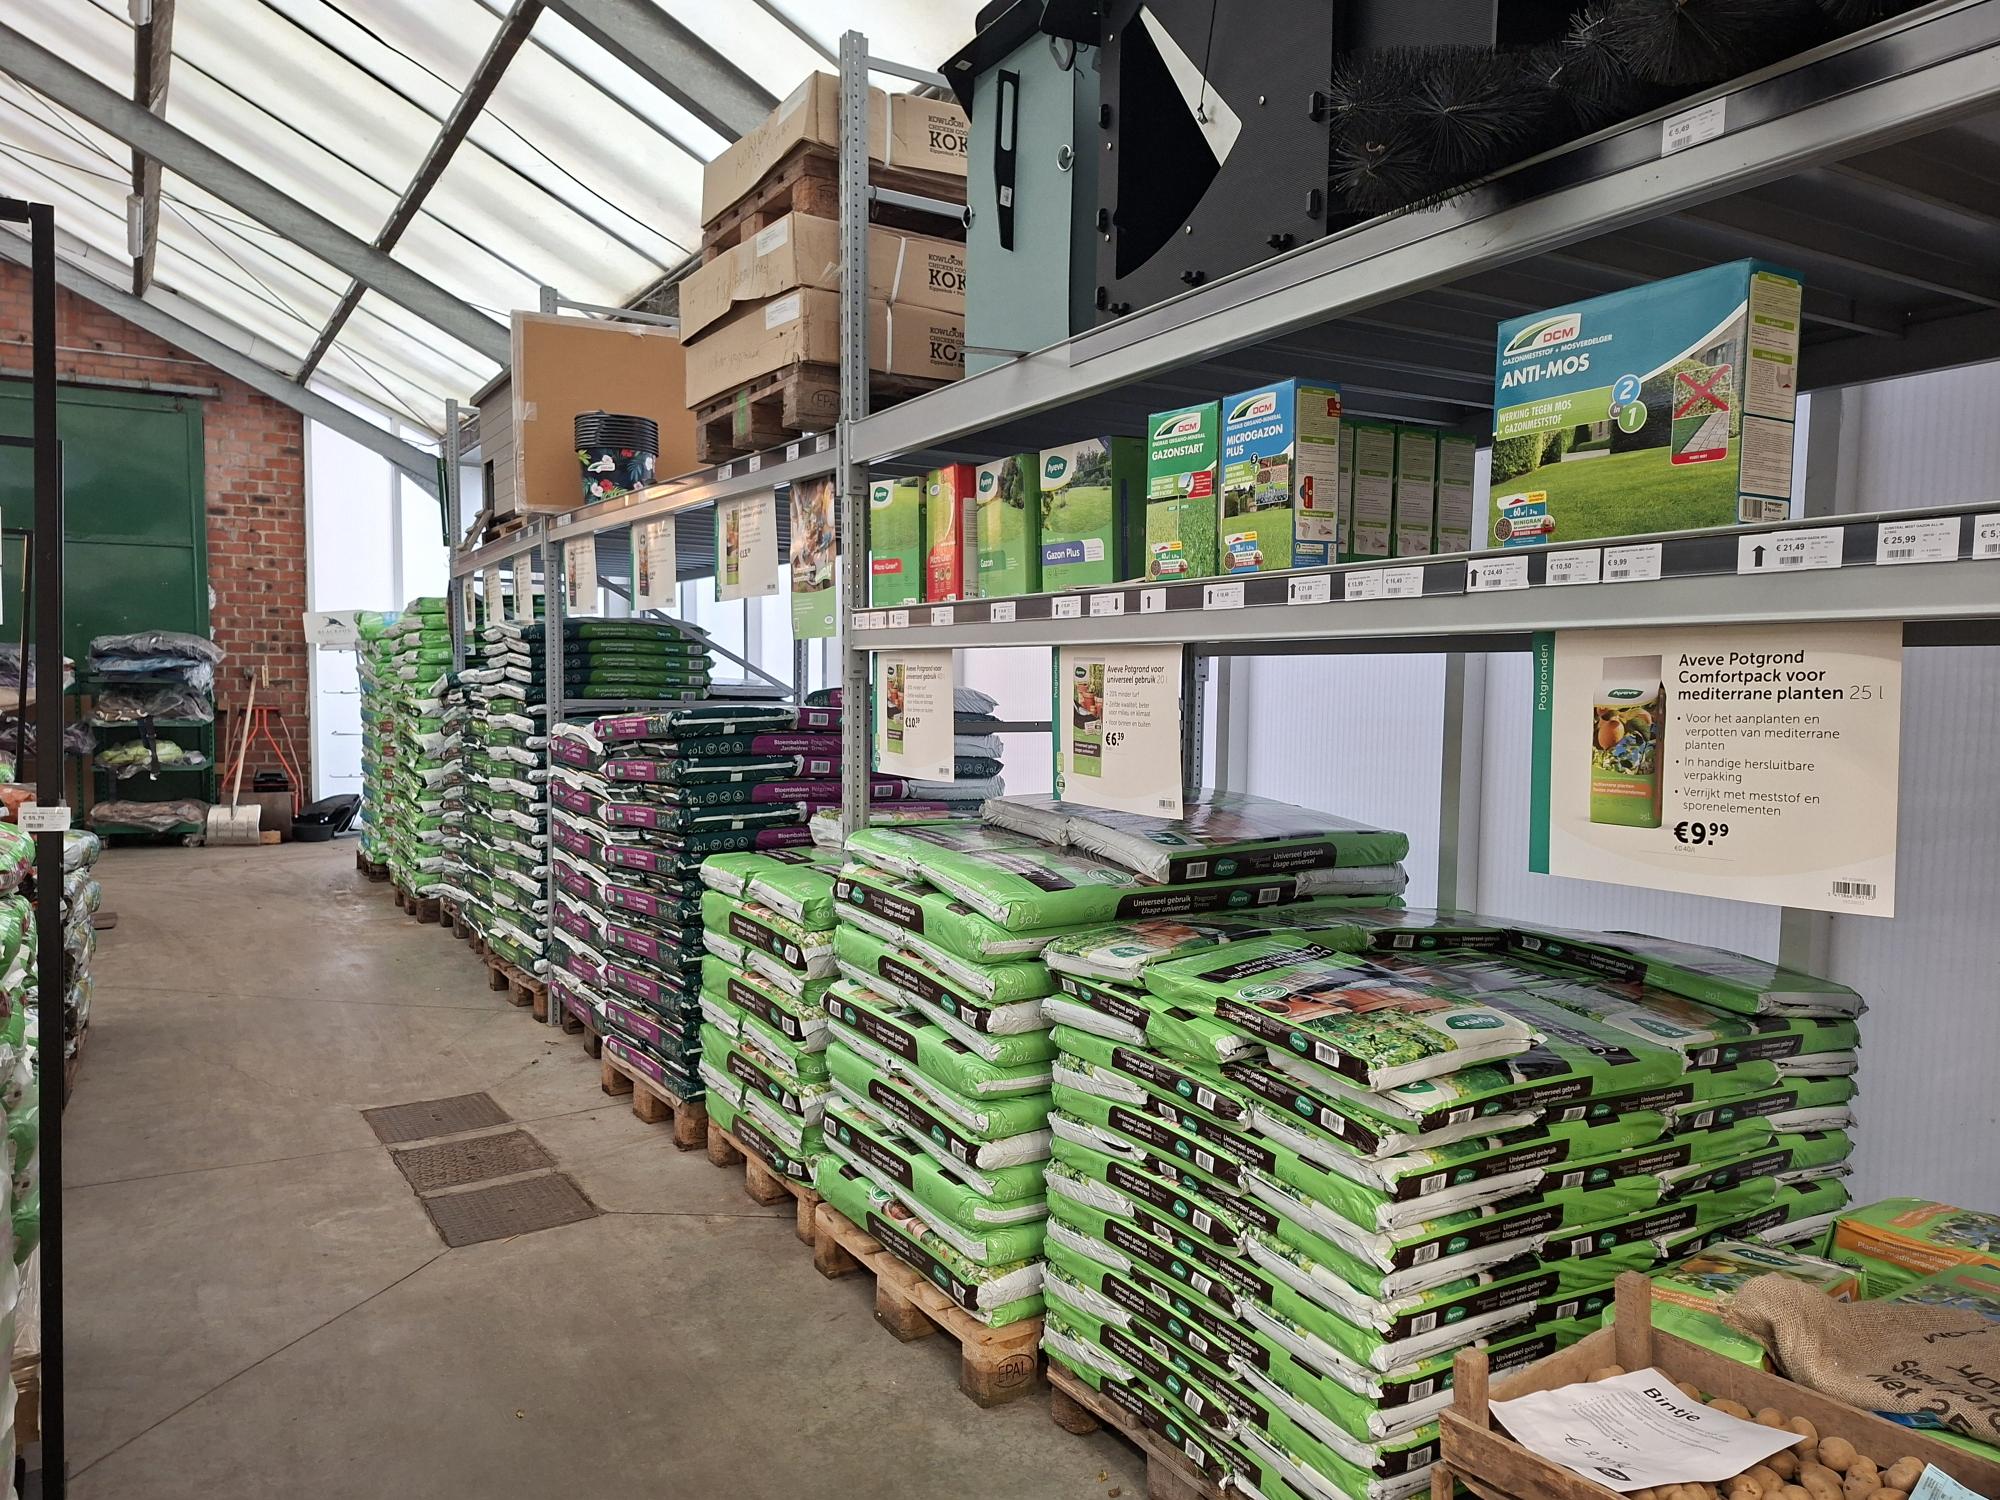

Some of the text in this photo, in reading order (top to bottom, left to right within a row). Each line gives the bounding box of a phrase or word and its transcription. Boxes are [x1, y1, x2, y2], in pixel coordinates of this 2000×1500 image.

[1543, 327, 1575, 343] DCM
[1502, 334, 1612, 366] GAZONMESTSTOF MOSVERDELGER
[1501, 353, 1590, 390] ANTI-MOS
[1253, 404, 1272, 415] DCM
[1619, 380, 1632, 400] 2
[1628, 407, 1636, 427] 1
[1500, 400, 1572, 423] WERKING TEGEN MOS
[1178, 423, 1197, 432] DCM
[1504, 415, 1562, 434] GAZONMESTSTOF
[1226, 424, 1283, 446] MICROGAZON
[1152, 443, 1204, 461] GAZONSTART
[1226, 445, 1244, 457] PLUS
[1892, 535, 1916, 544] 25,99
[1990, 530, 2000, 538] 5,
[1046, 549, 1080, 559] Gazon Plus
[1784, 543, 1805, 552] 21,49
[1679, 650, 1805, 668] Aveve Potgrond
[1108, 665, 1123, 674] Aveve
[1124, 664, 1149, 675] Potgrond
[1538, 644, 1549, 710] Potgronden
[1679, 669, 1826, 685] Comfortpack voor
[1106, 674, 1166, 686] universeel gebruik 20
[1678, 687, 1773, 700] mediterrane
[1777, 686, 1844, 703] planten
[1849, 686, 1874, 700] 25
[1686, 713, 1820, 727] Voor het aanplanten en
[1685, 727, 1840, 740] verpotten van mediterrane
[1684, 740, 1726, 753] planten
[1684, 758, 1815, 772] In handige hersluitbare
[1684, 771, 1742, 784] verpakking
[1684, 787, 1820, 804] Verrijkt met meststof en
[1683, 801, 1782, 817] sporenelementen
[1274, 849, 1323, 860] Universeel gebruik
[1273, 857, 1315, 868] Usage universel
[1134, 895, 1191, 907] Universeel gebruik
[1141, 904, 1190, 915] Usage universel
[1534, 1084, 1581, 1098] Universeel gebruik
[1509, 1148, 1557, 1164] Universeel gebruik
[1524, 1157, 1549, 1167] universel
[1503, 1213, 1552, 1230] Universeel gebruik
[1518, 1223, 1544, 1234] universel
[1500, 1279, 1547, 1299] Universeel gebruik
[1497, 1343, 1544, 1362] Universeel gebruik
[998, 1360, 1028, 1383] EPAL
[1867, 1374, 1923, 1398] Net
[1642, 1386, 1701, 1422] Bintje
